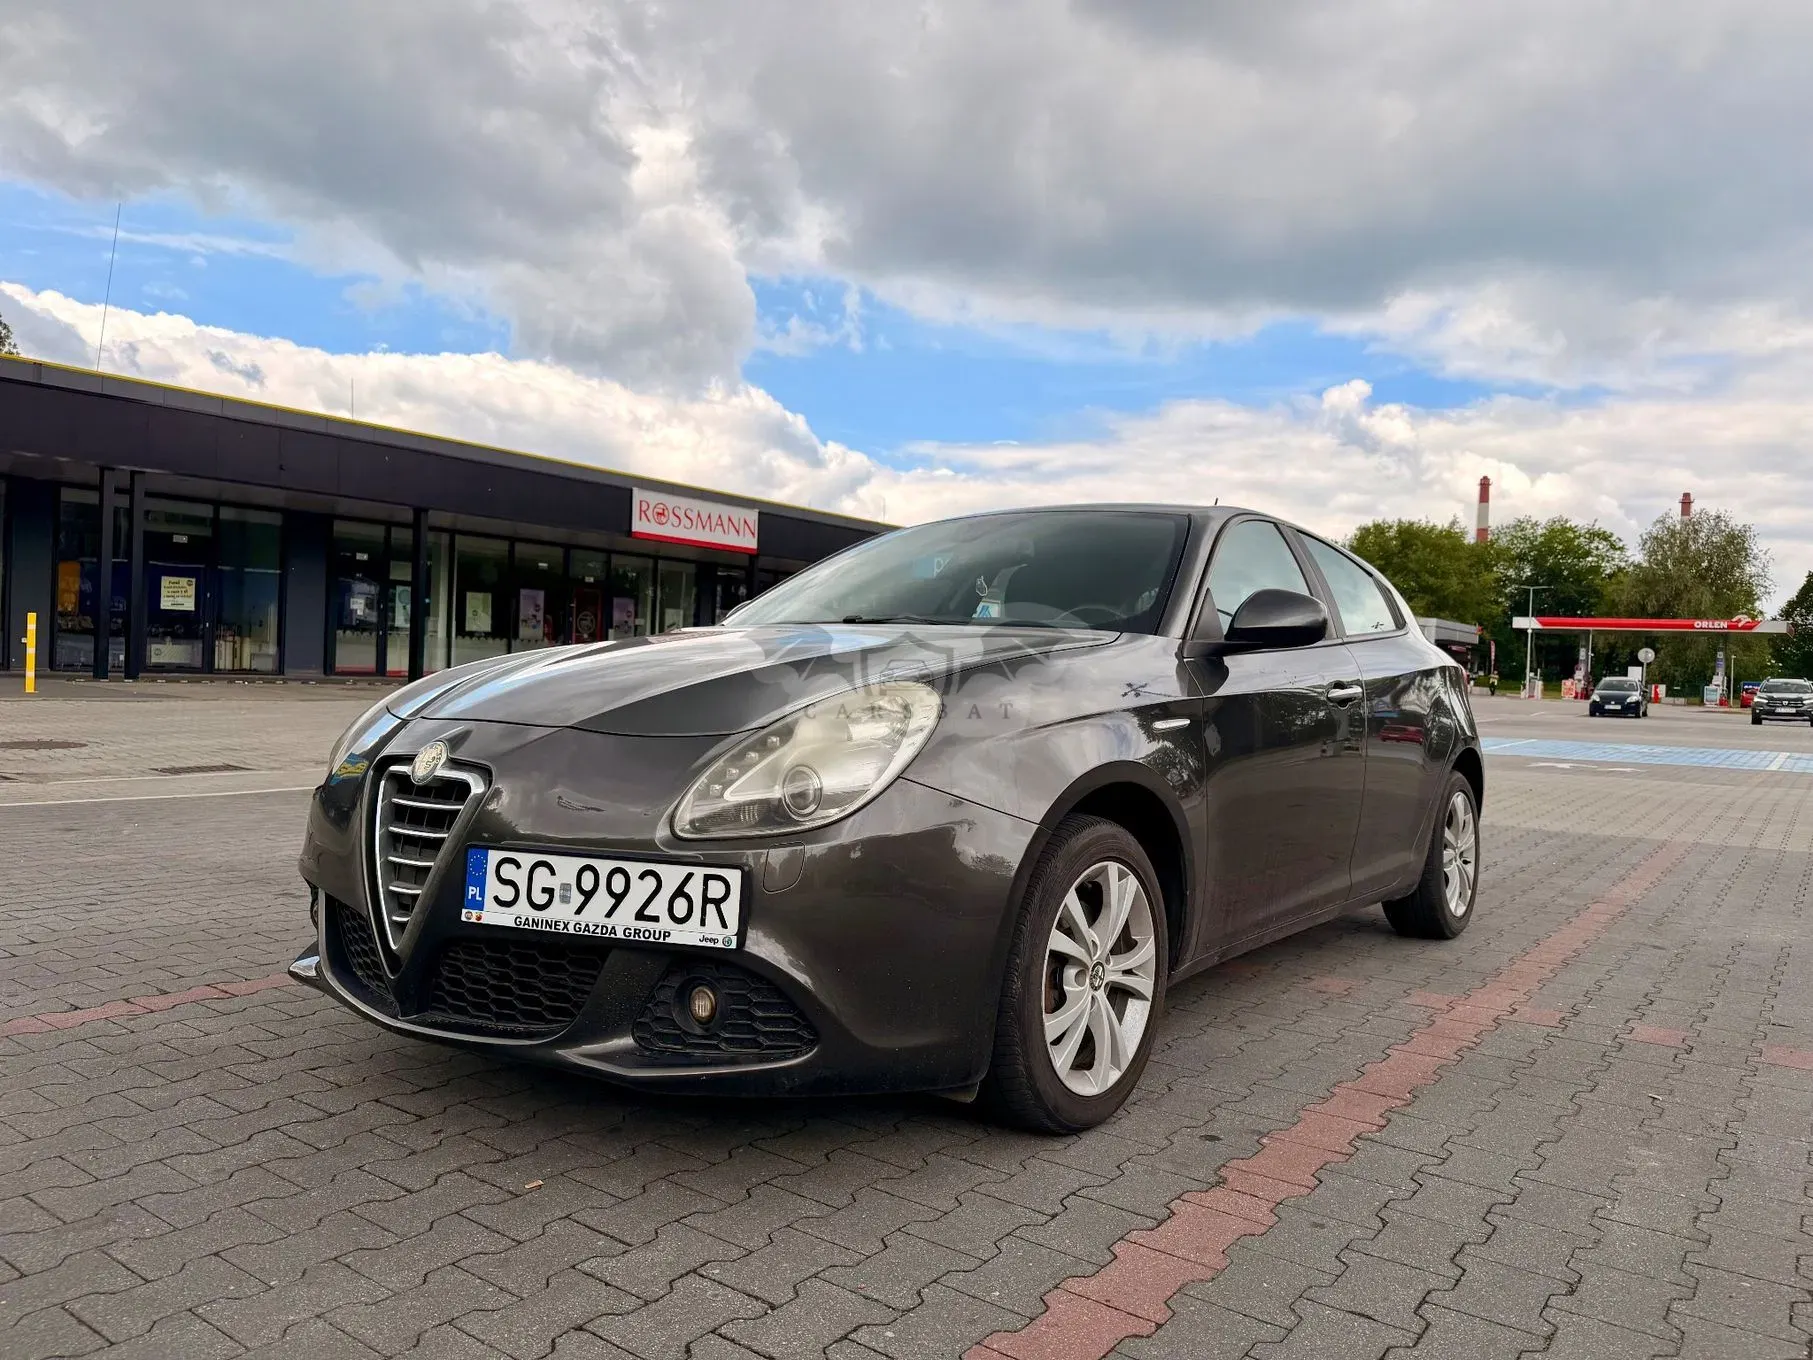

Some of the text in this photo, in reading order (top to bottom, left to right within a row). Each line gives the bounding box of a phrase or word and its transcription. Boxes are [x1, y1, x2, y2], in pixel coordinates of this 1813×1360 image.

[638, 499, 756, 539] ROSSMANN
[1694, 621, 1728, 629] ORLEN
[468, 886, 482, 901] PL
[492, 856, 731, 930] SG 9926R
[514, 916, 671, 942] GANINEX GAZDA GROUP
[699, 935, 719, 945] Jeep
